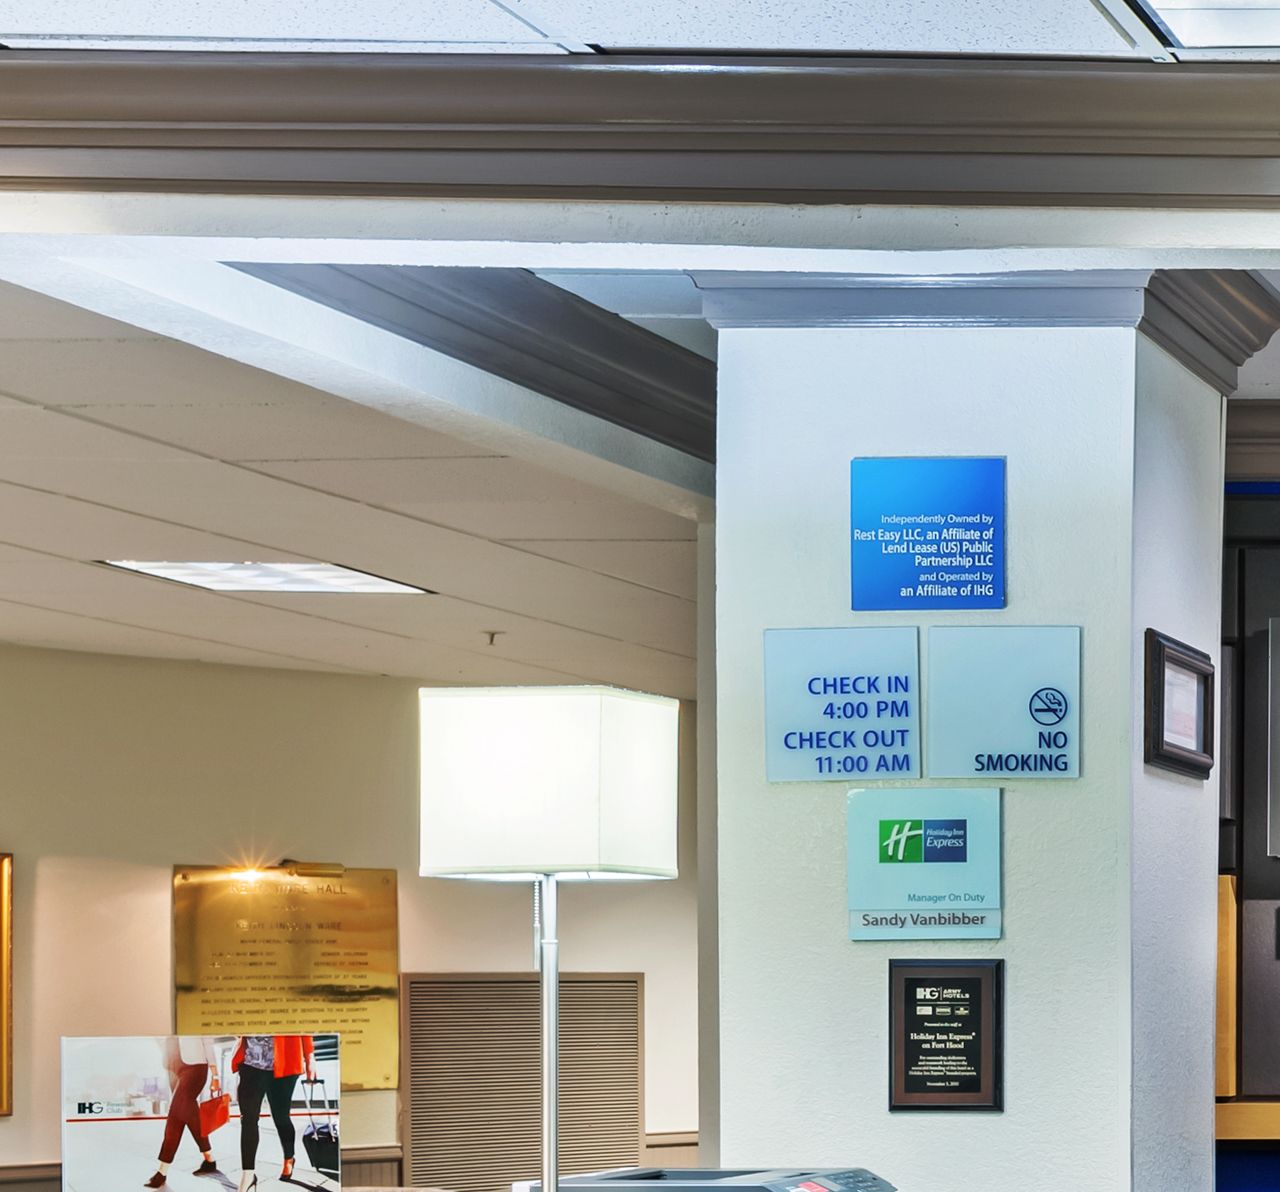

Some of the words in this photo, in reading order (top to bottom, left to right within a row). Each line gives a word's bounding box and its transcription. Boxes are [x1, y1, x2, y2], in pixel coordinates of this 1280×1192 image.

[881, 514, 946, 525] Independently
[947, 514, 980, 524] Owned
[982, 514, 993, 525] by
[854, 529, 875, 540] Rest
[878, 529, 901, 543] Easy
[903, 529, 924, 541] LLC,
[926, 531, 939, 540] an
[941, 528, 980, 540] Affiliate
[982, 528, 994, 540] of
[882, 542, 907, 553] Lend
[909, 542, 937, 553] Lease
[940, 542, 960, 554] (US)
[962, 541, 993, 553] Public
[915, 555, 973, 568] Partnership
[975, 555, 993, 566] LLC
[919, 572, 937, 581] and
[938, 572, 980, 583] Operated
[982, 572, 993, 582] by
[900, 587, 913, 596] an
[916, 585, 957, 596] Affiliate
[960, 584, 972, 596] of
[974, 585, 993, 596] IHG
[808, 676, 880, 695] CHECK
[887, 675, 909, 693] IN
[823, 702, 868, 719] 4:00
[876, 700, 909, 718] PM
[784, 730, 856, 749] CHECK
[863, 730, 909, 747] OUT
[1038, 731, 1068, 749] NO
[815, 756, 868, 773] 11:00
[875, 754, 910, 772] AM
[974, 754, 1068, 772] SMOKING
[926, 828, 952, 837] Holiday
[926, 837, 964, 848] Express
[317, 884, 346, 894] HALL
[908, 893, 946, 904] Manager
[948, 893, 961, 901] On
[963, 893, 985, 903] Duty
[862, 913, 907, 928] Sandy
[909, 912, 986, 925] Vanbibber
[916, 987, 939, 999] IHG
[910, 1032, 935, 1041] Holiday
[936, 1032, 948, 1040] Inn
[78, 1102, 104, 1114] IHG
